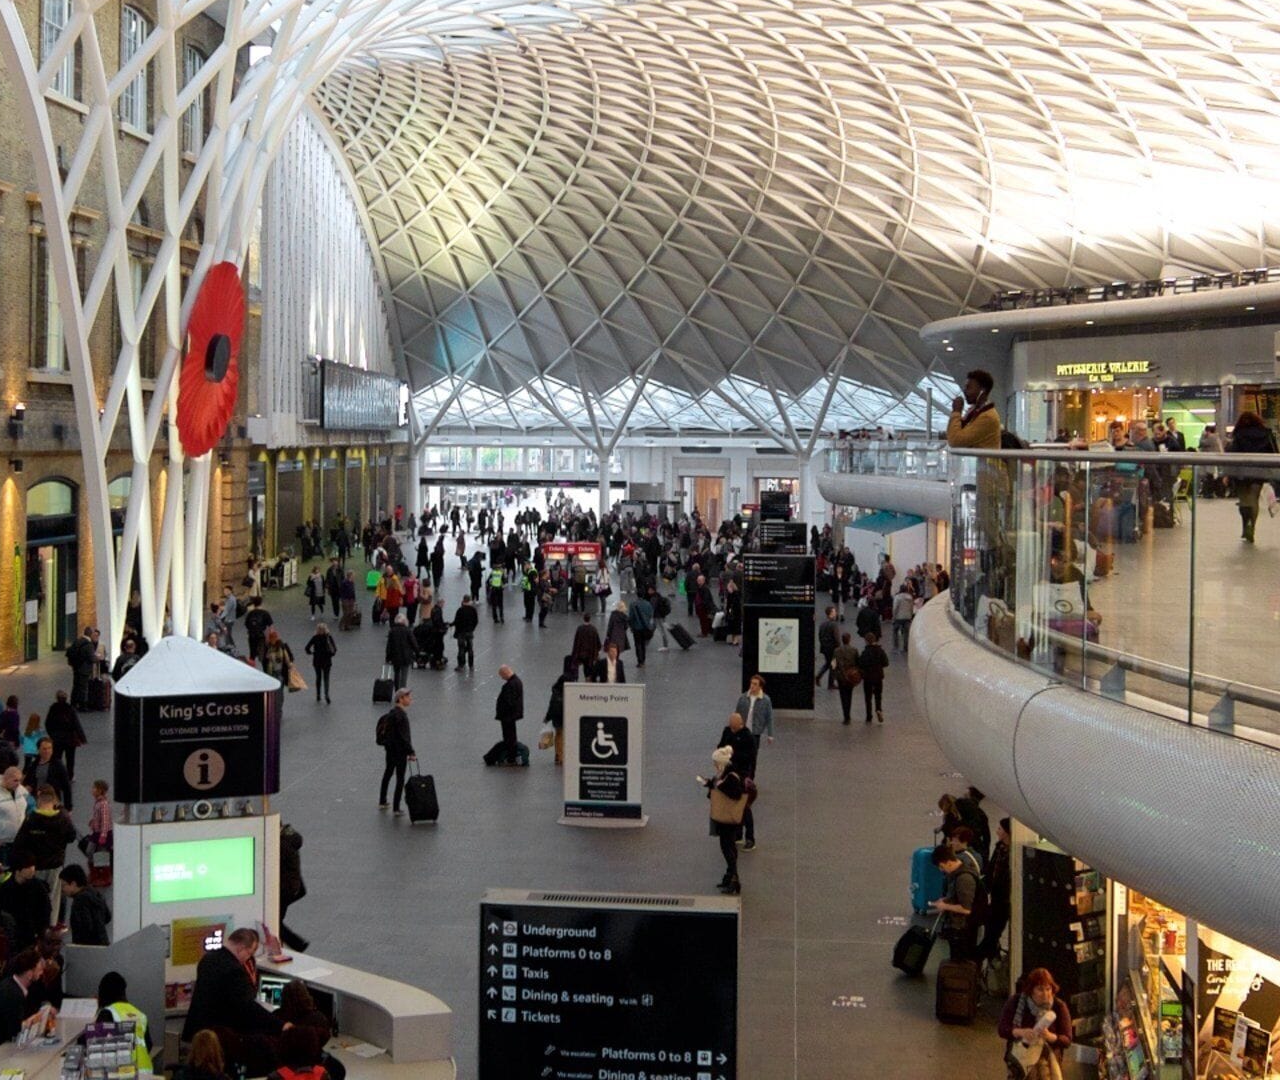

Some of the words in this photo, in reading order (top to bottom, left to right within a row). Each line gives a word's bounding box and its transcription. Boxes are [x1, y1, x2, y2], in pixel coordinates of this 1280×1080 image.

[1056, 363, 1107, 376] PATISSERIE
[1108, 361, 1150, 373] VALERIE
[579, 694, 609, 703] Meeting
[610, 694, 629, 702] Point
[159, 704, 203, 720] King's
[206, 702, 250, 716] Cross
[159, 727, 199, 736] CUSTOMER
[201, 724, 250, 734] INFORMATION
[522, 924, 597, 939] Underground
[522, 946, 576, 959] Platforms
[578, 949, 586, 959] 0
[588, 950, 601, 960] to
[603, 950, 612, 960] 8
[1206, 959, 1224, 971] THE
[521, 968, 549, 979] Taxis
[521, 990, 558, 1003] Dining
[560, 991, 570, 1002] &
[572, 992, 614, 1007] seating
[521, 1010, 561, 1024] Tickets
[601, 1048, 656, 1062] Platforms
[658, 1051, 666, 1061] 0
[668, 1052, 681, 1062] to
[683, 1052, 692, 1062] 8
[598, 1069, 635, 1080] Dining
[638, 1071, 646, 1080] &
